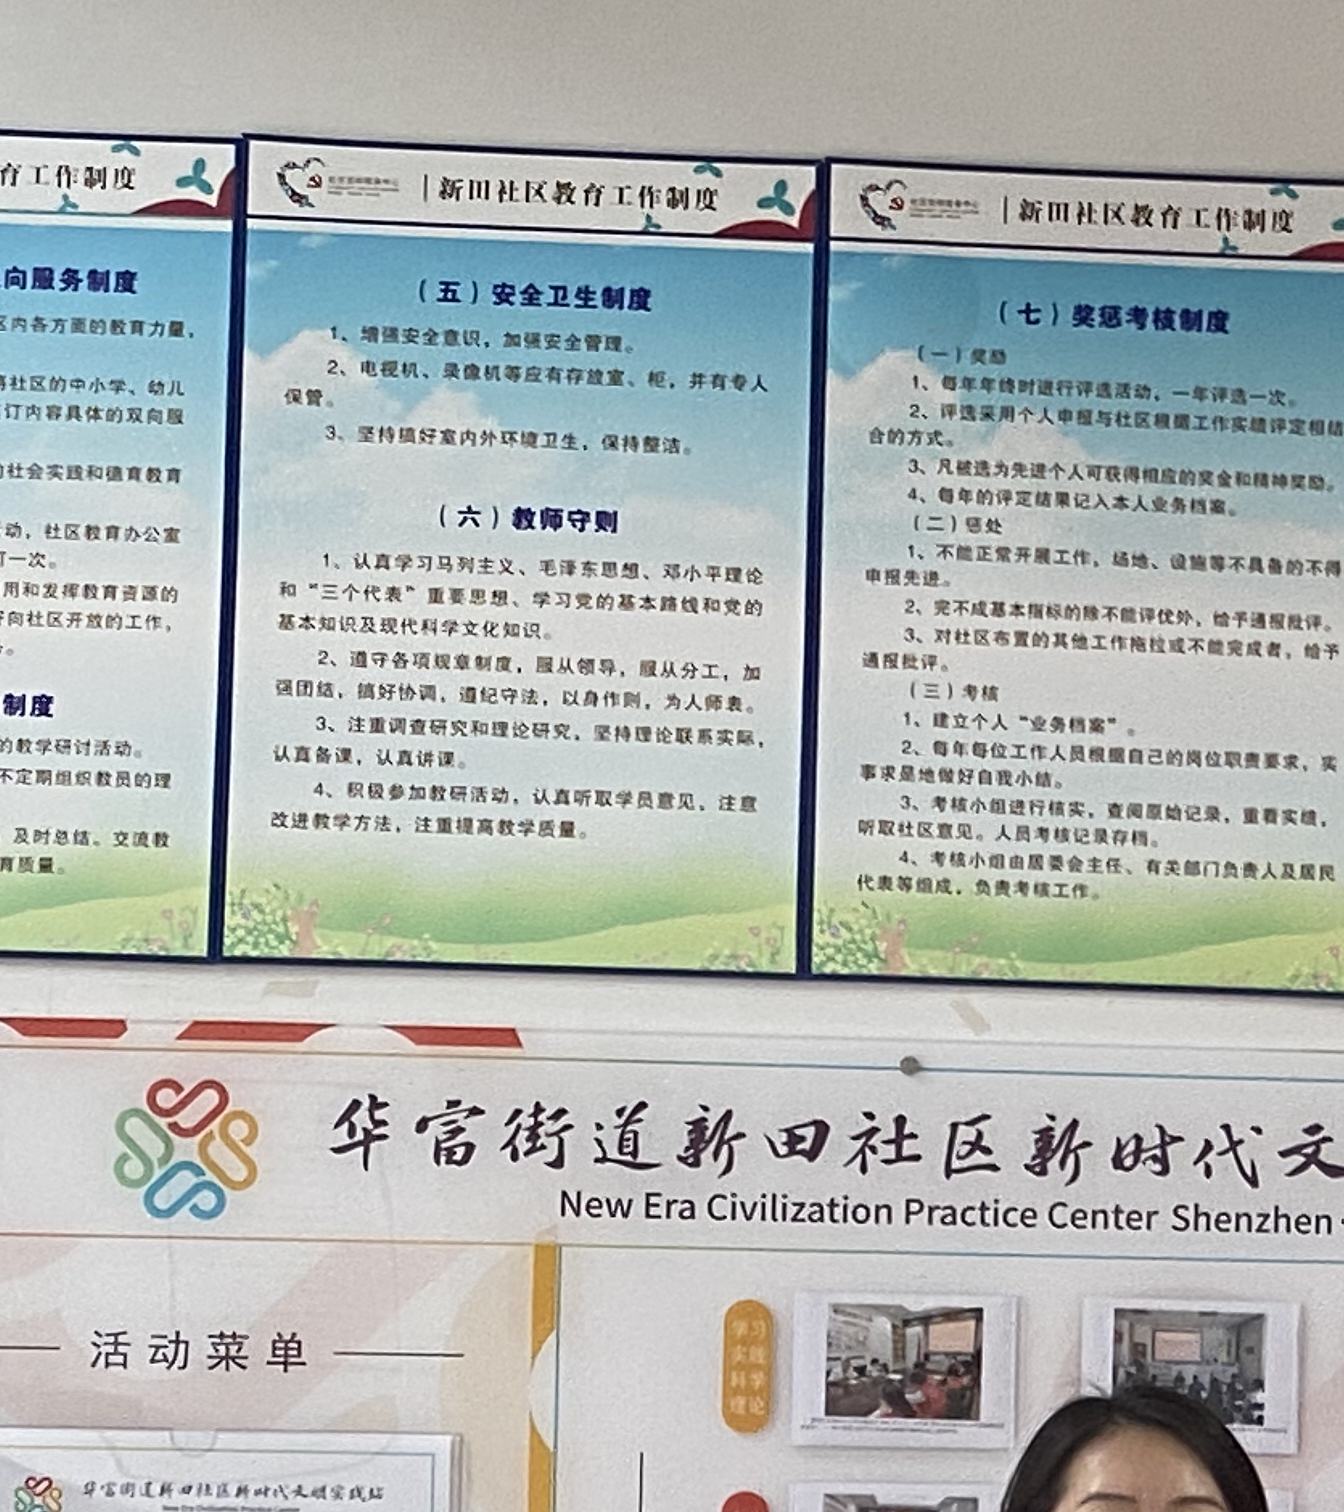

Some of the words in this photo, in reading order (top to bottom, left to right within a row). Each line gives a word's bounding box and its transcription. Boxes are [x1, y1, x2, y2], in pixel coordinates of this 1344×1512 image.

[438, 175, 721, 212] 新田社区教育工作制度
[1017, 198, 1295, 235] 新田社区教育工作制度
[0, 266, 138, 294] 向服务制度
[868, 428, 954, 449] 合的方式。
[0, 521, 181, 545] 动，社区教育办公室
[438, 504, 619, 534] （六）教师守则
[4, 693, 54, 718] 制度
[560, 1190, 634, 1221] New
[643, 1191, 699, 1222] Era
[705, 1191, 894, 1226] Civilization
[903, 1196, 1038, 1230] Practice
[1047, 1200, 1160, 1233] Center
[89, 1328, 309, 1374] 活动菜单
